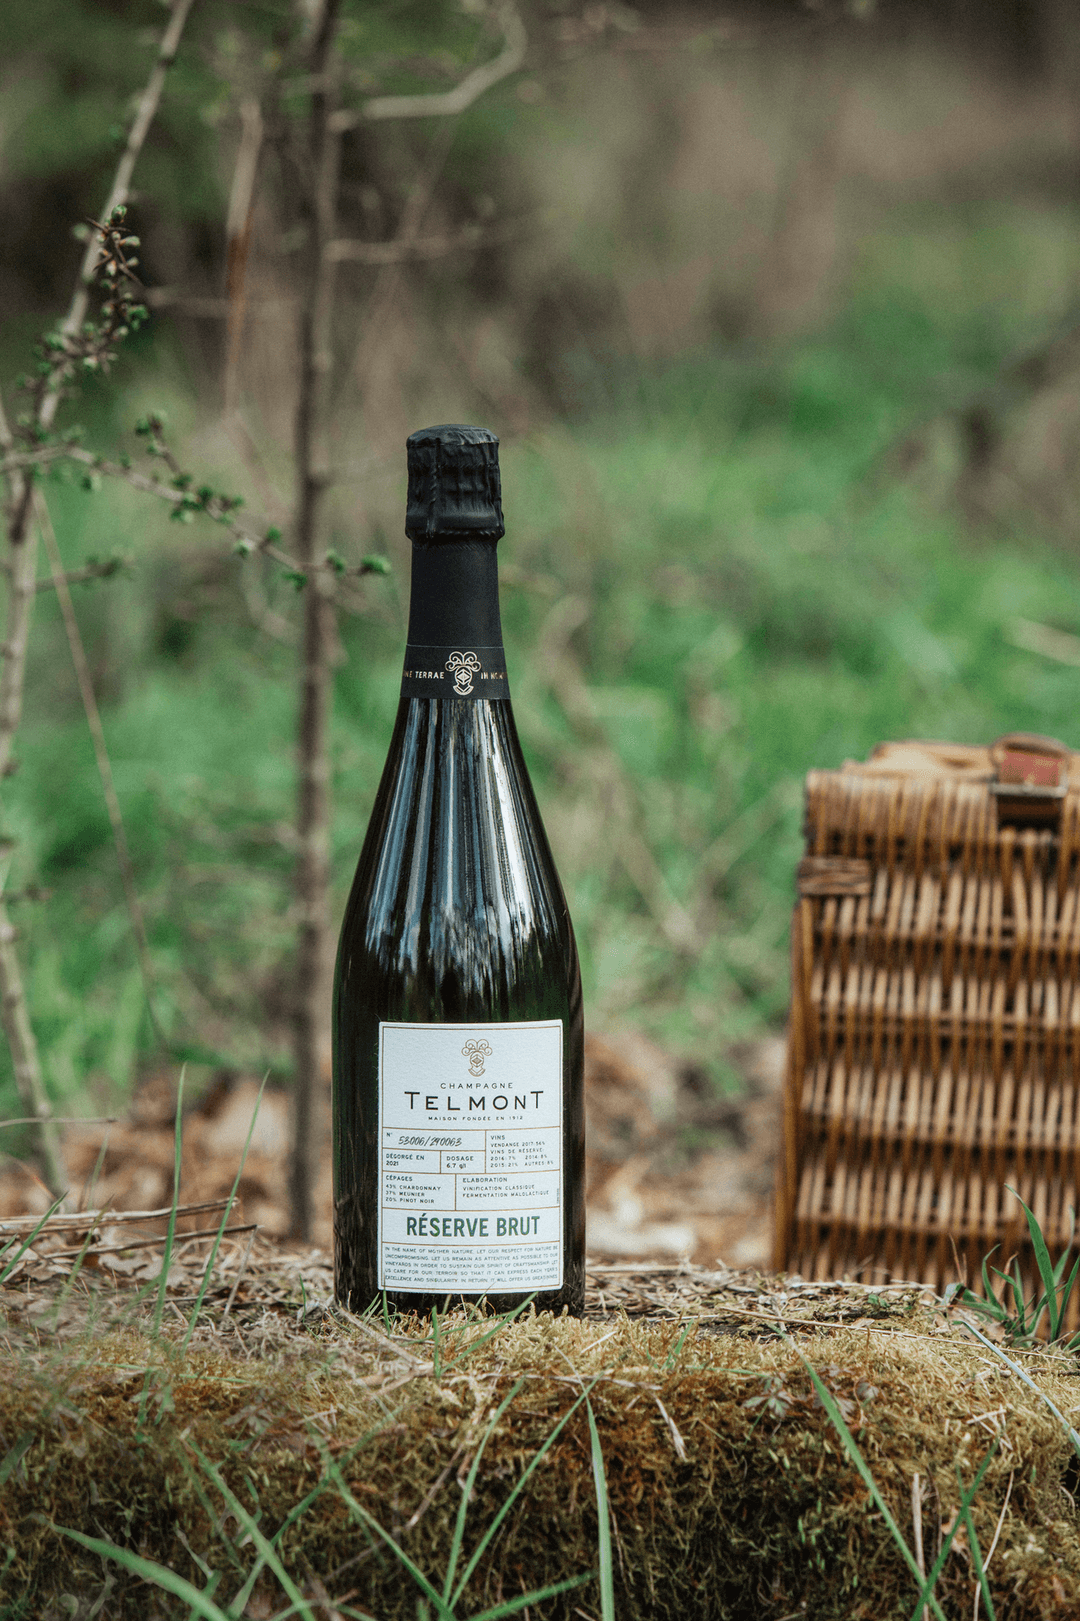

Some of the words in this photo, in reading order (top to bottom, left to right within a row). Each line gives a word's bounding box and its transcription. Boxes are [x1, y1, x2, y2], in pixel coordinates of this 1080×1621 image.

[415, 671, 444, 679] TERRAE
[404, 1091, 544, 1111] TELMONT
[407, 1213, 489, 1237] RÉSERVE
[497, 1216, 540, 1237] BRUT
